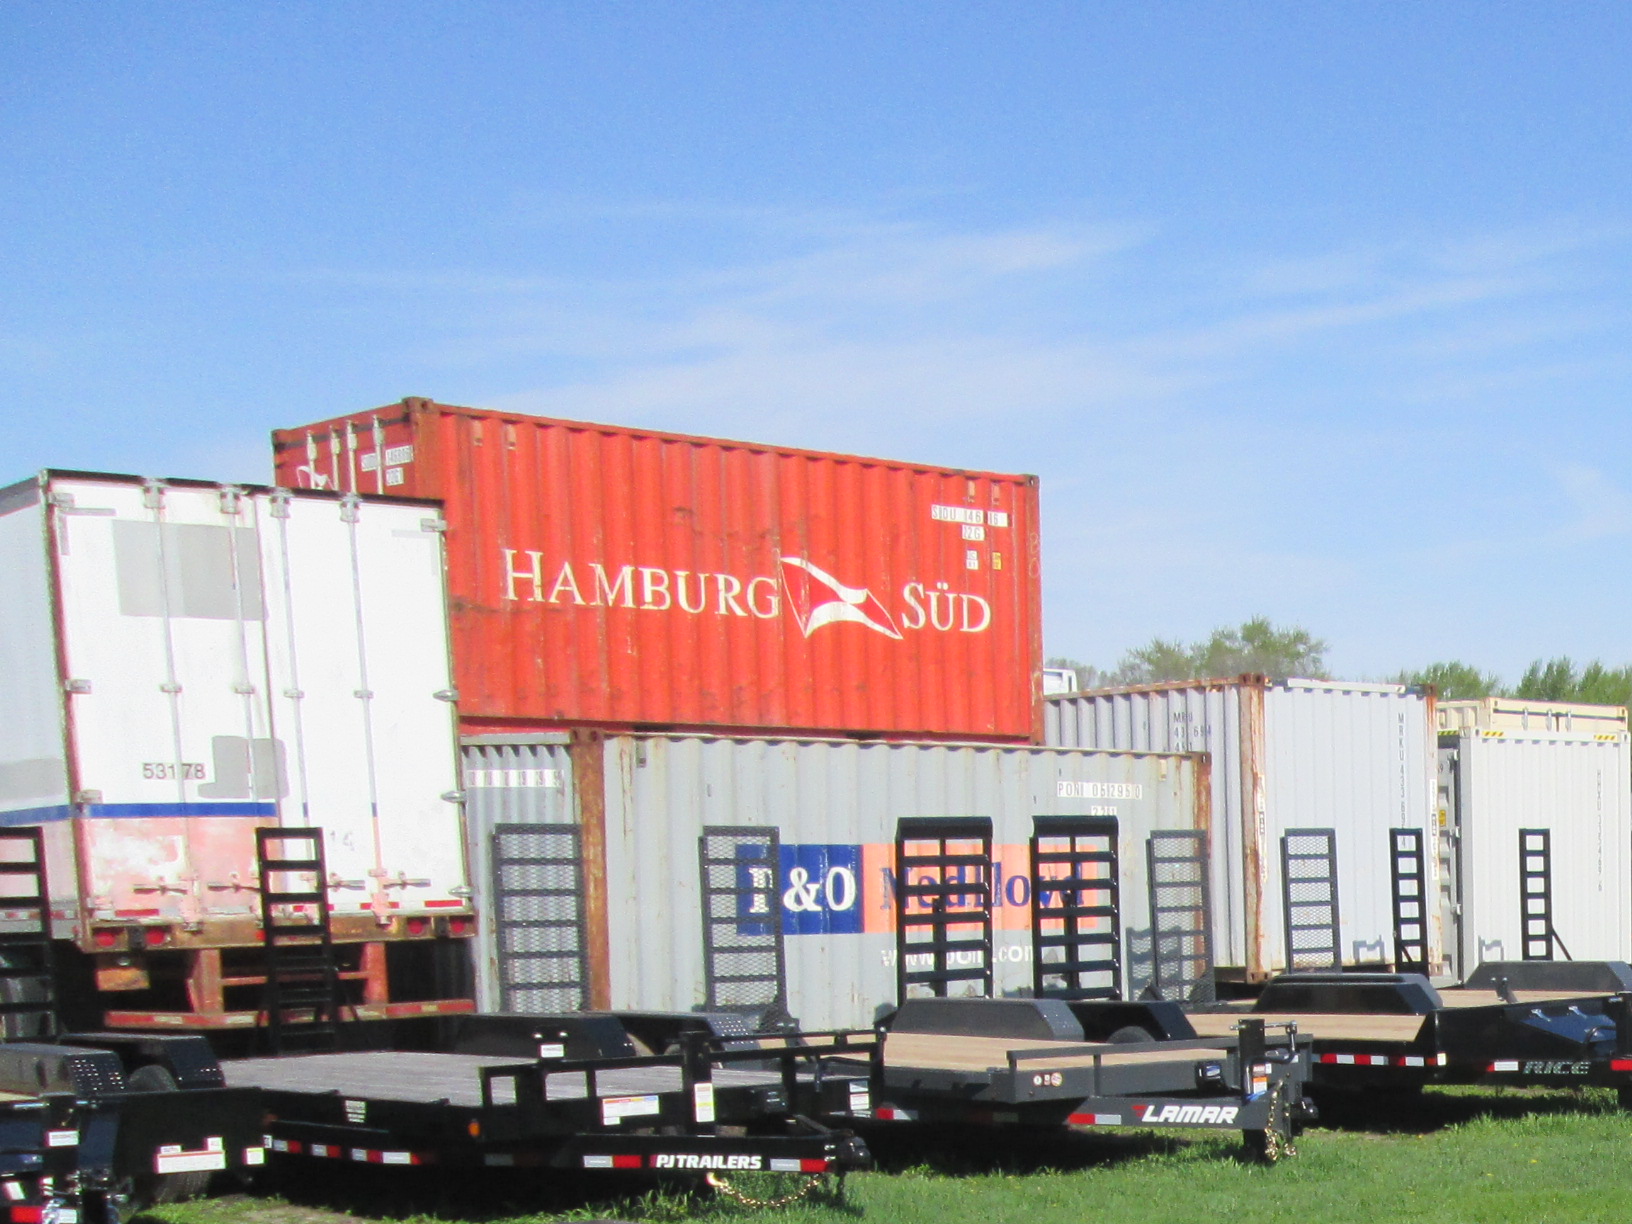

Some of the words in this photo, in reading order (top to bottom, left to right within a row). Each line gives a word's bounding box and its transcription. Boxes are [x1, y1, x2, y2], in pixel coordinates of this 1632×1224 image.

[503, 549, 780, 619] HAMBURG
[901, 582, 991, 634] SÜD
[143, 763, 206, 780] 53178
[1523, 1061, 1591, 1074] RICE
[1141, 1105, 1239, 1124] LAMAR
[676, 1155, 762, 1169] TRAILERS
